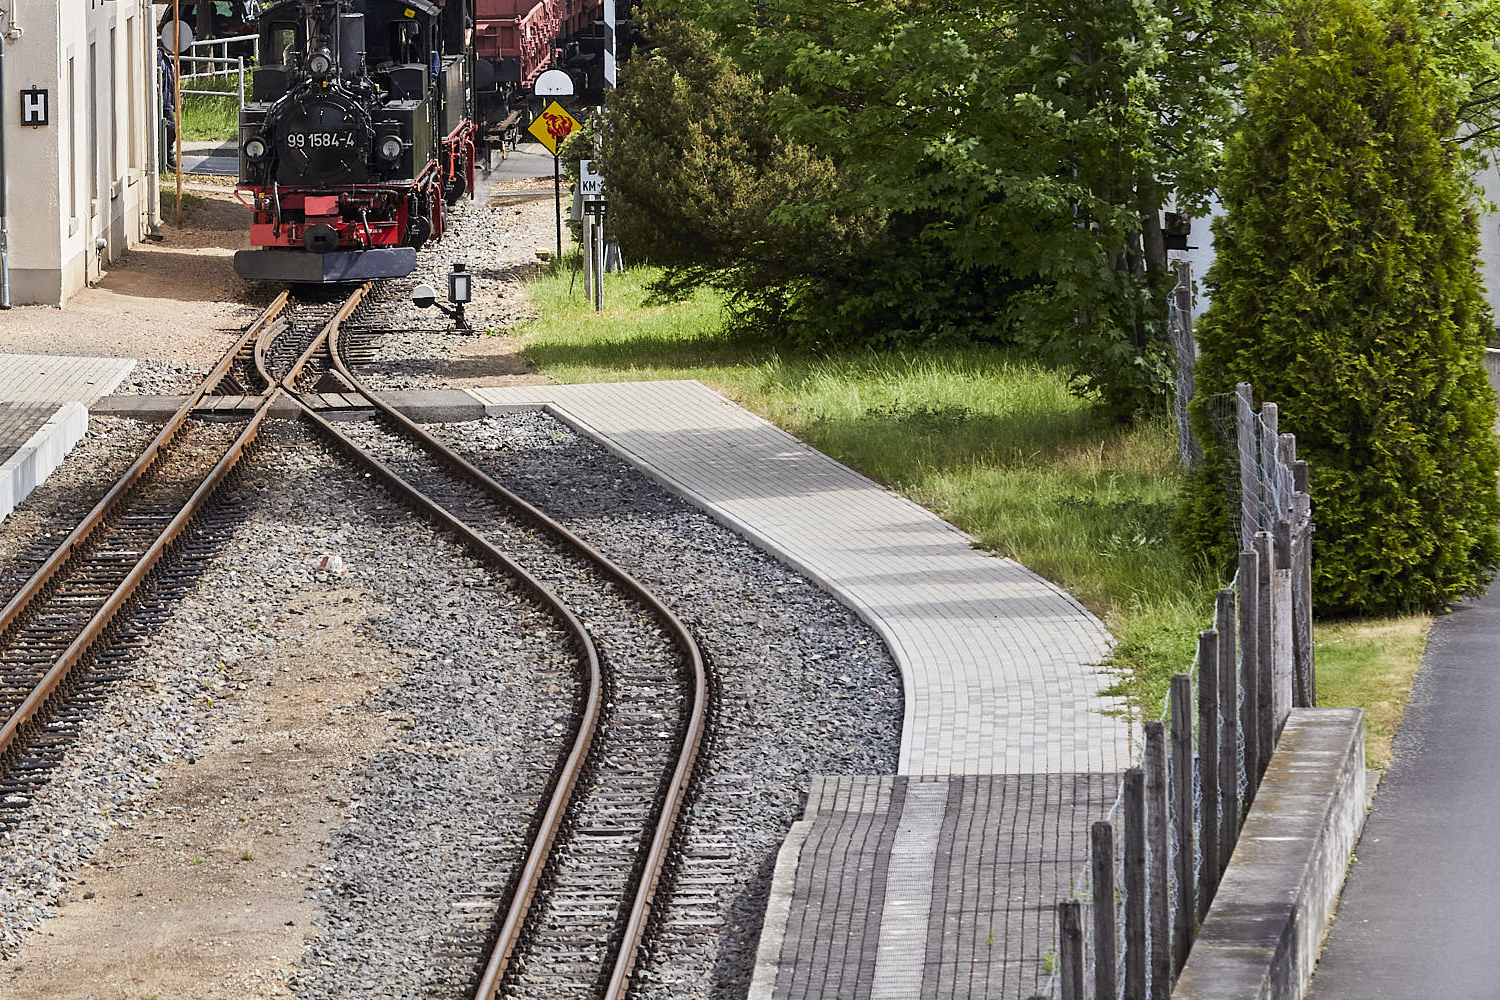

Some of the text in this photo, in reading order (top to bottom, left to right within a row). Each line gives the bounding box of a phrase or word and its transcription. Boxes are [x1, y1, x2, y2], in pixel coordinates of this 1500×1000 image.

[25, 93, 45, 121] H
[287, 132, 355, 148] 99 1584-4
[582, 180, 596, 192] KM
